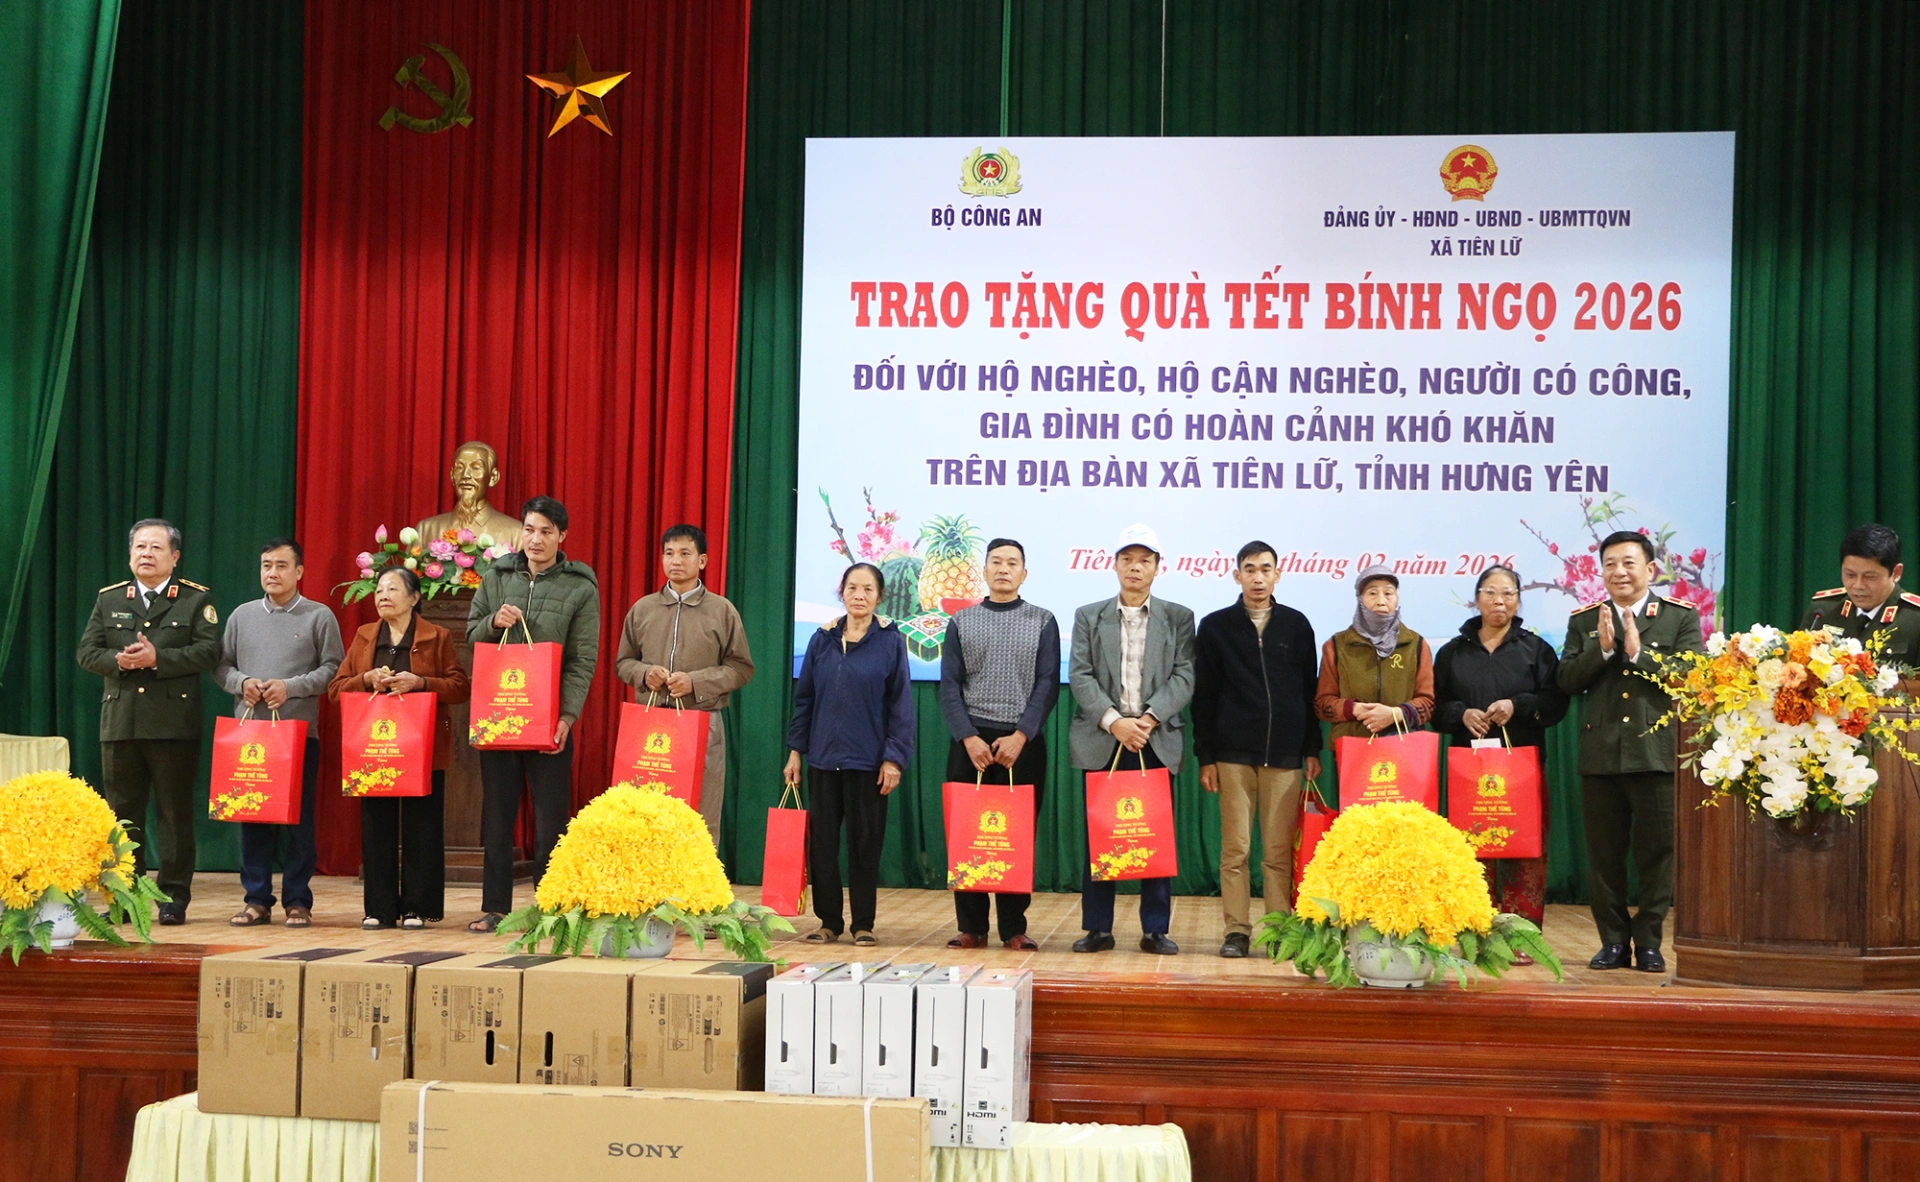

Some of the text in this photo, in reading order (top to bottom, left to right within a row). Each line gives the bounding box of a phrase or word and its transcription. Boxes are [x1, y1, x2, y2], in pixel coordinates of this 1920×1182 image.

[931, 204, 1042, 231] BỘ CÔNG AN
[1323, 205, 1369, 228] ĐẢNG
[1374, 204, 1396, 228] ỦY
[1412, 210, 1458, 228] HĐND
[1475, 210, 1522, 228] UBND
[1539, 209, 1631, 229] UBMTTQVN
[1430, 235, 1523, 257] XÃ TIÊN LỮ
[850, 265, 1682, 343] TRAO TẶNG QUÀ TẾT BÍNH NGỌ 2026
[853, 354, 1691, 400] ĐỐI VỚI HỘ NGHÈO, HỘ CẬN NGHÈO, NGƯỜI CÓ CÔNG,
[980, 405, 1554, 444] GIA ĐÌNH CÓ HOÀN CẢNH KHÓ KHĂN
[926, 453, 1609, 493] TRÊN ĐỊA BÀN XÃ TIÊN LỮ, TỈNH HƯNG YÊN
[1176, 551, 1236, 578] ngày
[1279, 551, 1350, 580] tháng
[1393, 553, 1448, 575] năm
[1389, 653, 1404, 669] R
[966, 1111, 997, 1119] HDMI
[608, 1142, 684, 1159] SONY
